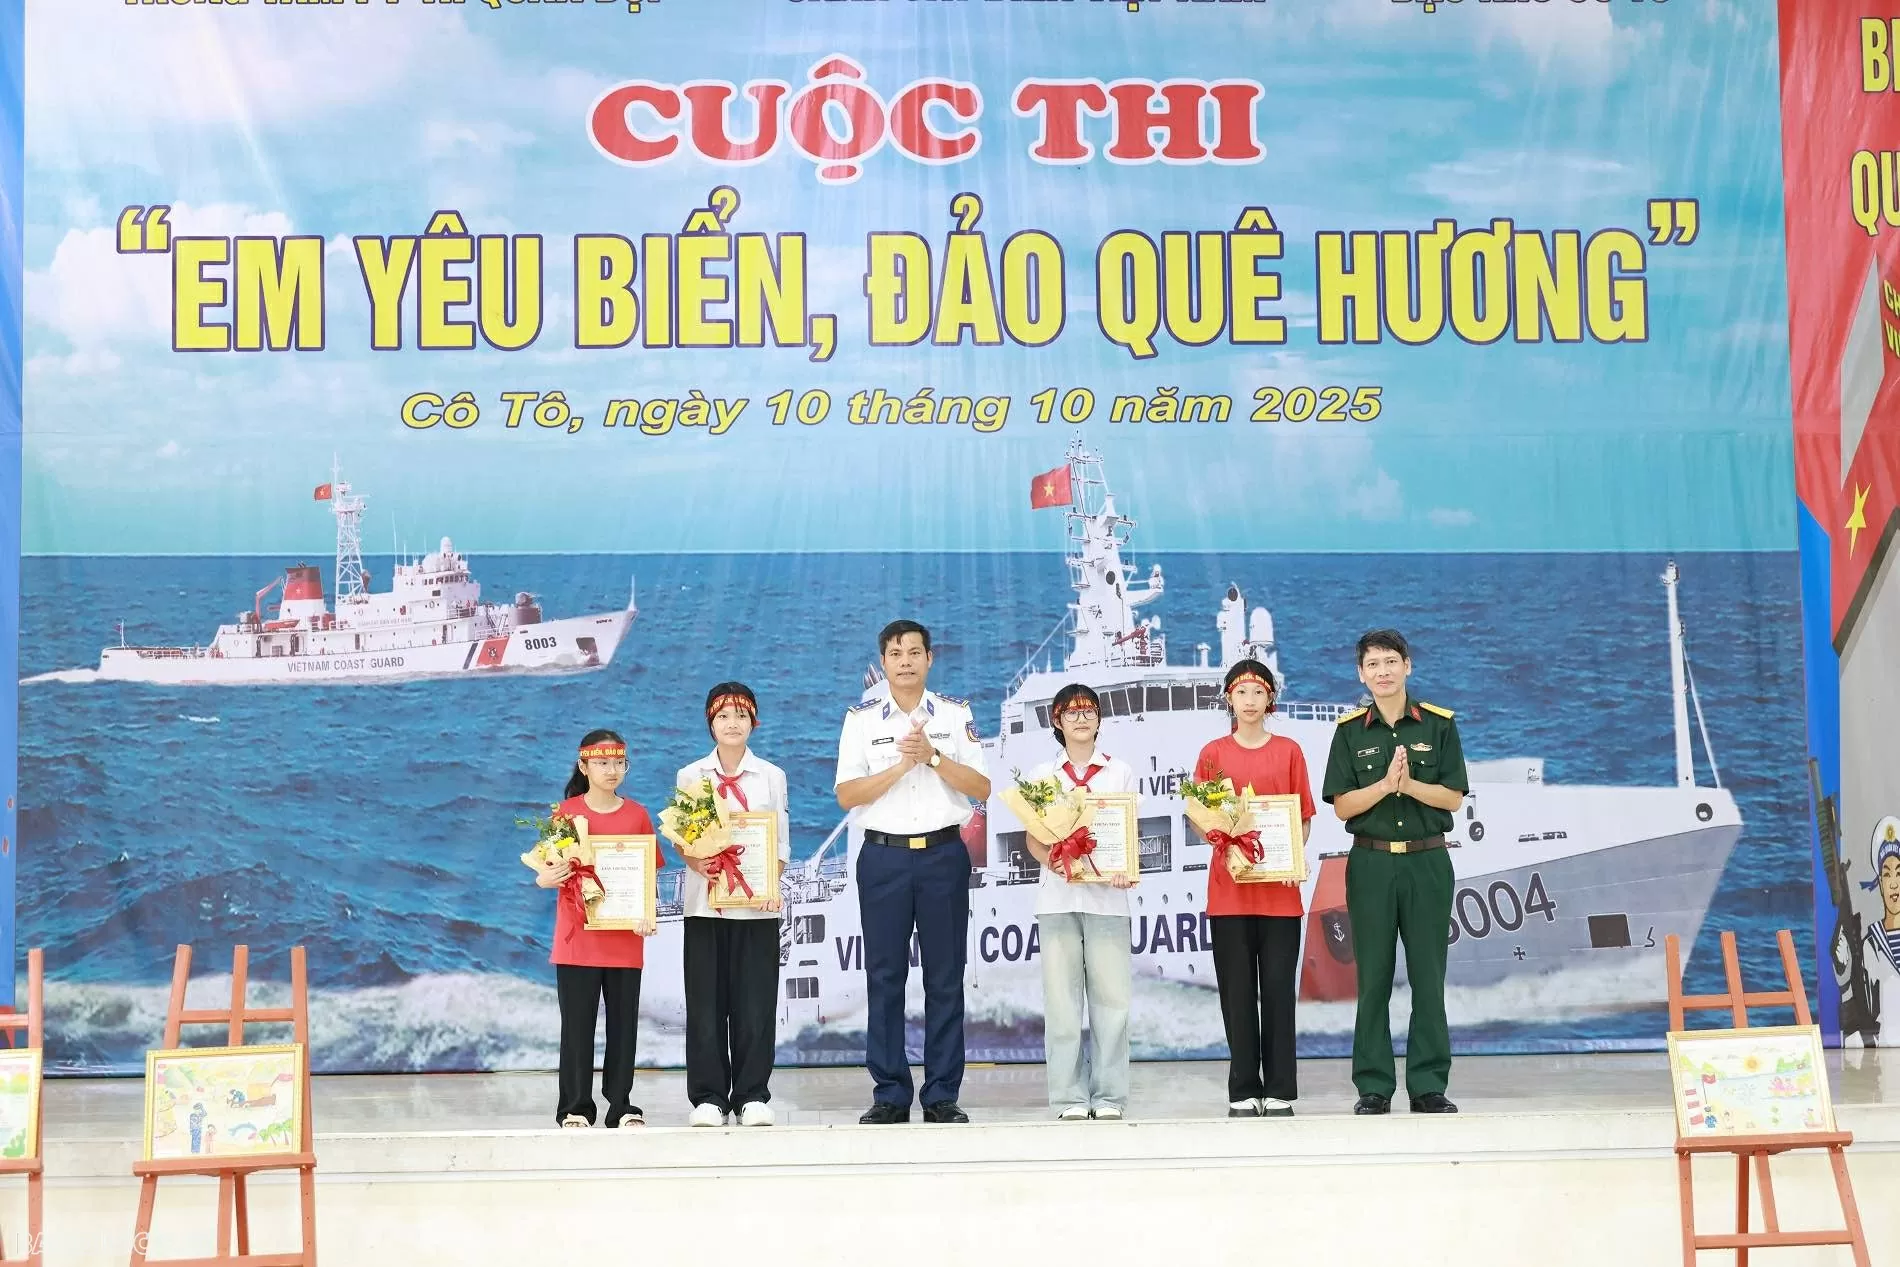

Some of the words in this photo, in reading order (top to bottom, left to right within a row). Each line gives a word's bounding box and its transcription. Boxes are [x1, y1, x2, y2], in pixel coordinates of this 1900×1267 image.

[588, 55, 981, 182] CUỘC
[1012, 79, 1265, 164] THI
[353, 209, 544, 352] YÊU
[573, 185, 839, 363] BIỂN,
[862, 191, 1066, 346] ĐẢO
[1095, 205, 1288, 360] QUÊ
[400, 391, 481, 430] Cô
[500, 391, 585, 434] Tô,
[603, 389, 751, 436] ngày
[766, 388, 832, 426] 10
[847, 387, 1012, 433] tháng
[1030, 387, 1096, 424] 10
[1109, 386, 1233, 424] năm
[1250, 386, 1383, 423] 2025
[287, 660, 330, 673] VIETNAM
[333, 658, 366, 671] COAST
[370, 656, 405, 669] GUARD
[524, 636, 557, 651] 8003
[980, 923, 1040, 963] COA
